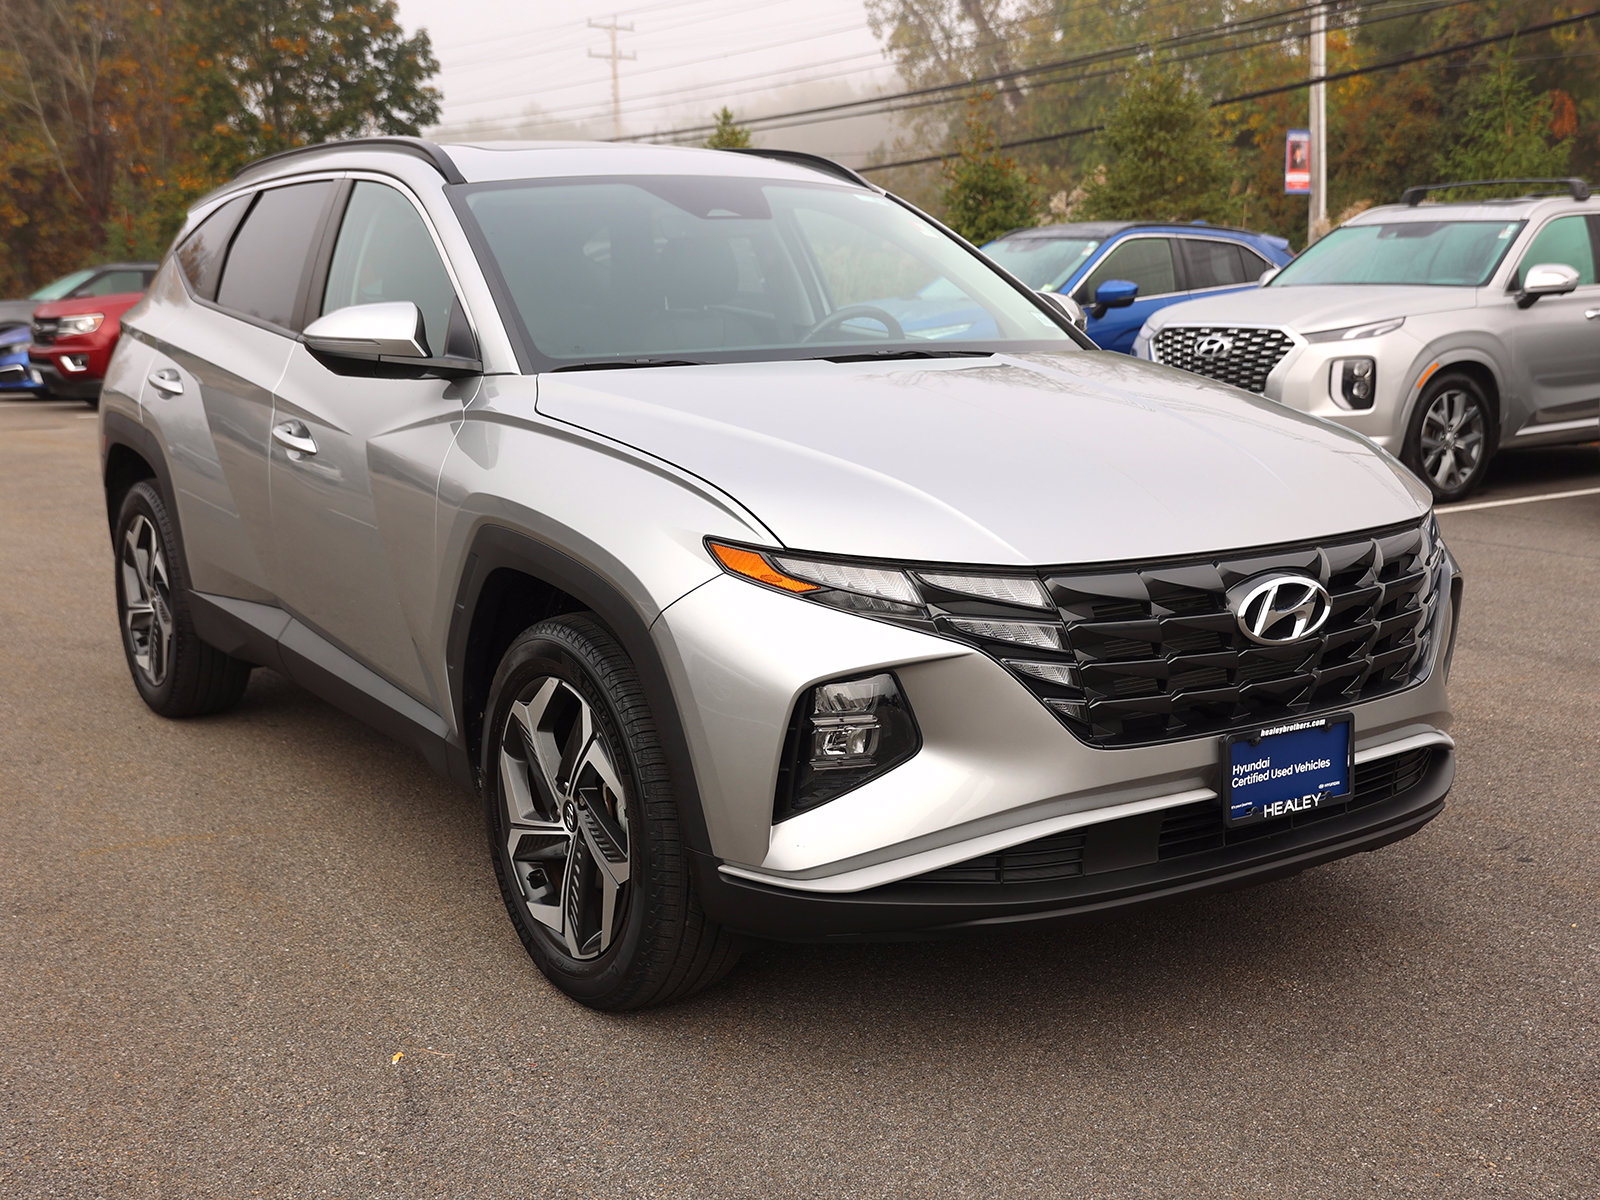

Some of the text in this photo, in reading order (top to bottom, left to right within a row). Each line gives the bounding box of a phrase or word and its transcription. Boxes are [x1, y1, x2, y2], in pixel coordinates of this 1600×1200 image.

[1260, 719, 1326, 737] healeybrothers.com
[1231, 758, 1331, 788] Certified Used Vehicles
[1232, 757, 1271, 776] Hyundai
[1263, 792, 1322, 818] HEALEY
